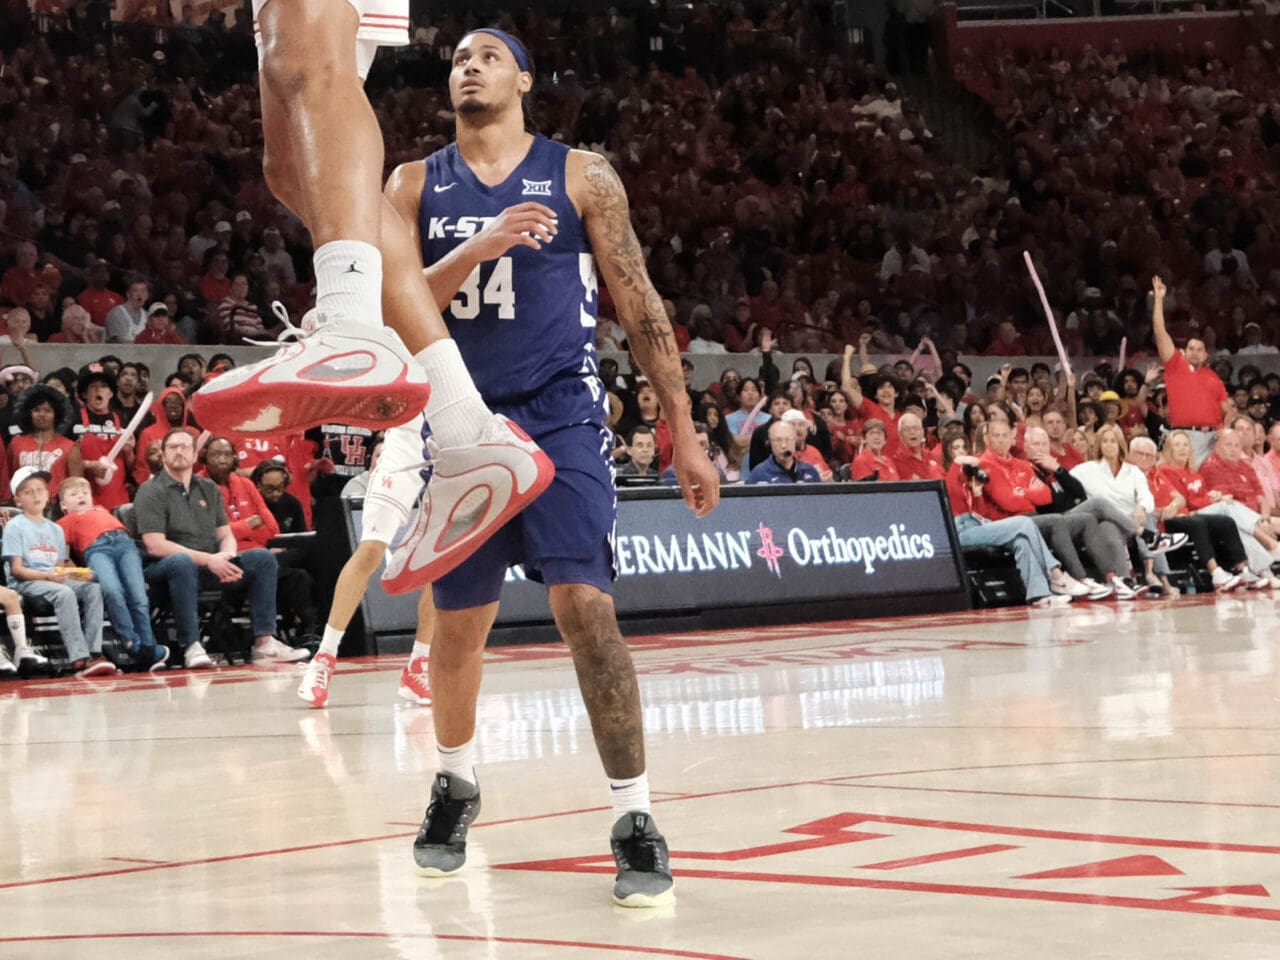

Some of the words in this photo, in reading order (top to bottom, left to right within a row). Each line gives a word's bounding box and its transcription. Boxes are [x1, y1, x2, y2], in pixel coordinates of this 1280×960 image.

[450, 256, 516, 320] 34
[341, 435, 367, 465] UH
[616, 530, 752, 575] ERMANN
[788, 523, 934, 574] Orthopedics
